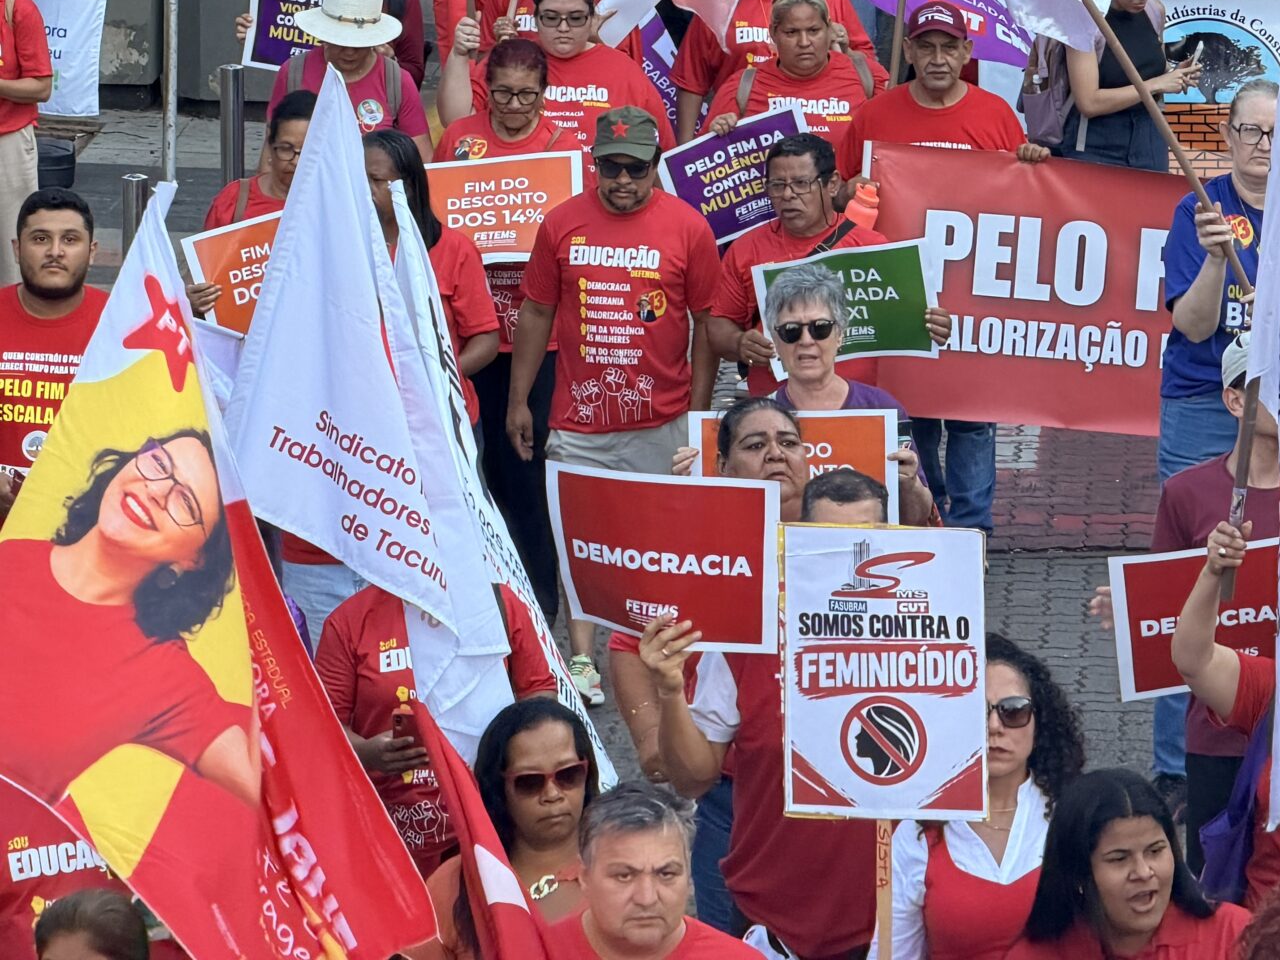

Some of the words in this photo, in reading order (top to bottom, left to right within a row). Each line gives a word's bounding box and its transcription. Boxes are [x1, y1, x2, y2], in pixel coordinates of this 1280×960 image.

[1164, 4, 1228, 29] ndústrias
[1230, 9, 1246, 22] da
[684, 151, 726, 178] PELO
[729, 139, 758, 158] FIM
[759, 129, 785, 145] DA
[464, 181, 496, 194] FIM
[501, 177, 529, 191] DO
[702, 168, 760, 198] CONTRA
[447, 192, 547, 210] DESCONTO
[735, 196, 772, 218] FETEMS
[447, 213, 499, 229] DOS
[503, 208, 545, 225] 14%
[473, 230, 517, 241] FETEMS
[570, 236, 587, 244] SOU
[240, 242, 271, 263] FIM
[569, 245, 661, 272] EDUCAÇÃO
[924, 208, 1108, 307] PELO
[630, 269, 661, 281] DEFENDO:
[850, 267, 883, 283] DA
[586, 282, 632, 292] DEMOCRACIA
[586, 296, 625, 306] SOBERANIA
[587, 309, 634, 321] VALORIZAÇÃO
[587, 325, 597, 335] FIM
[598, 326, 608, 334] DA
[609, 325, 645, 336] VIOLÊNCIA
[595, 334, 631, 344] MULHERES
[586, 346, 597, 356] FIM
[598, 348, 609, 357] DO
[609, 347, 643, 358] CONFISCO
[946, 313, 1149, 373] ALORIZAÇÃO
[2, 351, 24, 361] QUEM
[24, 352, 62, 363] CONSTRÓI
[586, 355, 595, 364] DA
[595, 354, 639, 366] PREVIDÊNCIA
[25, 363, 49, 374] TEMPO
[50, 365, 69, 375] PARA
[35, 380, 66, 401] FIM
[315, 409, 417, 485] Sindicato
[268, 426, 432, 536] Trabalhadores
[339, 511, 369, 542] de
[374, 530, 449, 594] Tacuru
[571, 537, 753, 578] DEMOCRACIA
[895, 589, 928, 599] MS
[625, 599, 679, 618] FETEMS
[899, 602, 928, 613] CUT
[798, 612, 865, 639] SOMOS
[869, 613, 951, 641] CONTRA
[955, 614, 970, 641] O
[801, 644, 976, 690] FEMINICÍDIO
